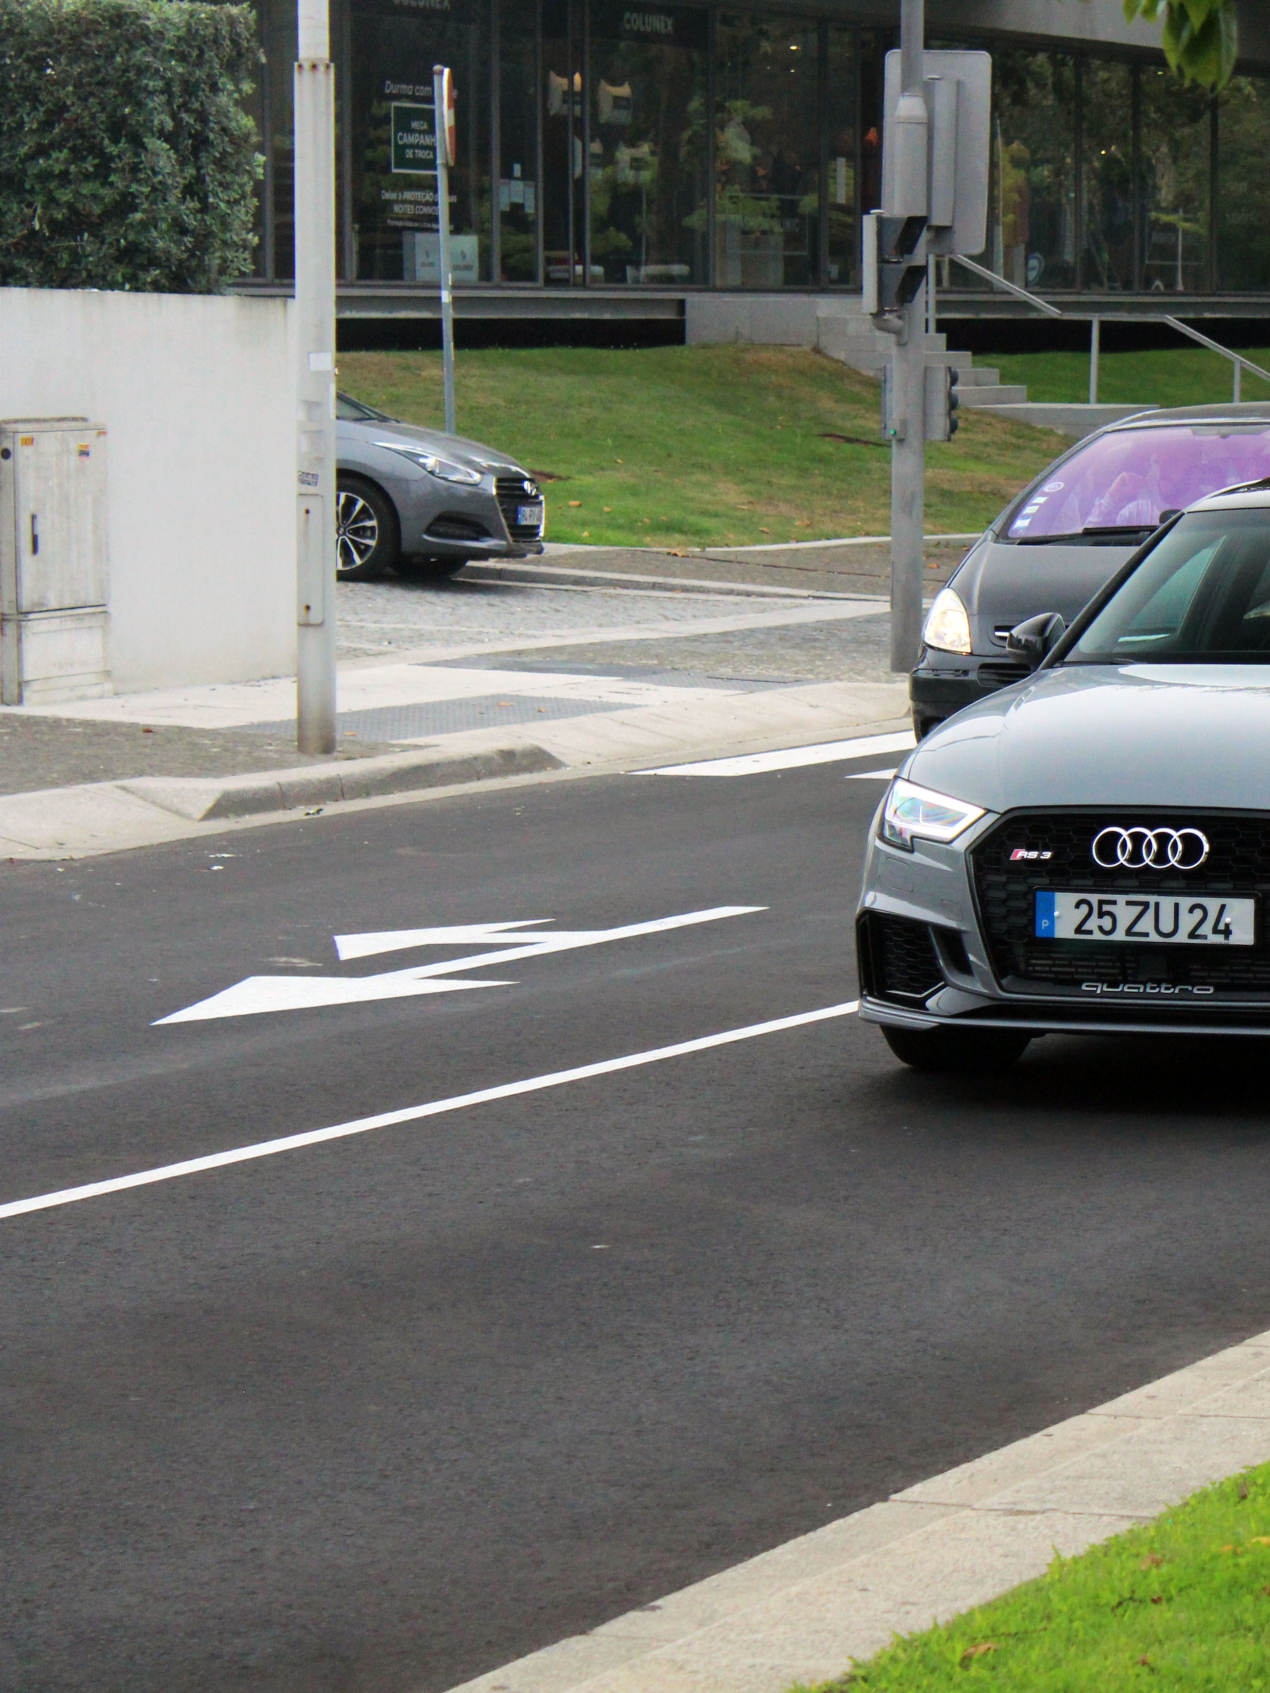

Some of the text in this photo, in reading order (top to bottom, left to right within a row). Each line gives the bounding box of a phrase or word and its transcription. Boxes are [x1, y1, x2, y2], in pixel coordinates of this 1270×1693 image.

[623, 11, 674, 35] COLUNEX
[385, 80, 433, 96] Durma com
[396, 131, 437, 147] CAMPANH
[393, 203, 415, 214] NOITES
[1041, 919, 1050, 930] P
[1081, 982, 1214, 994] quattro
